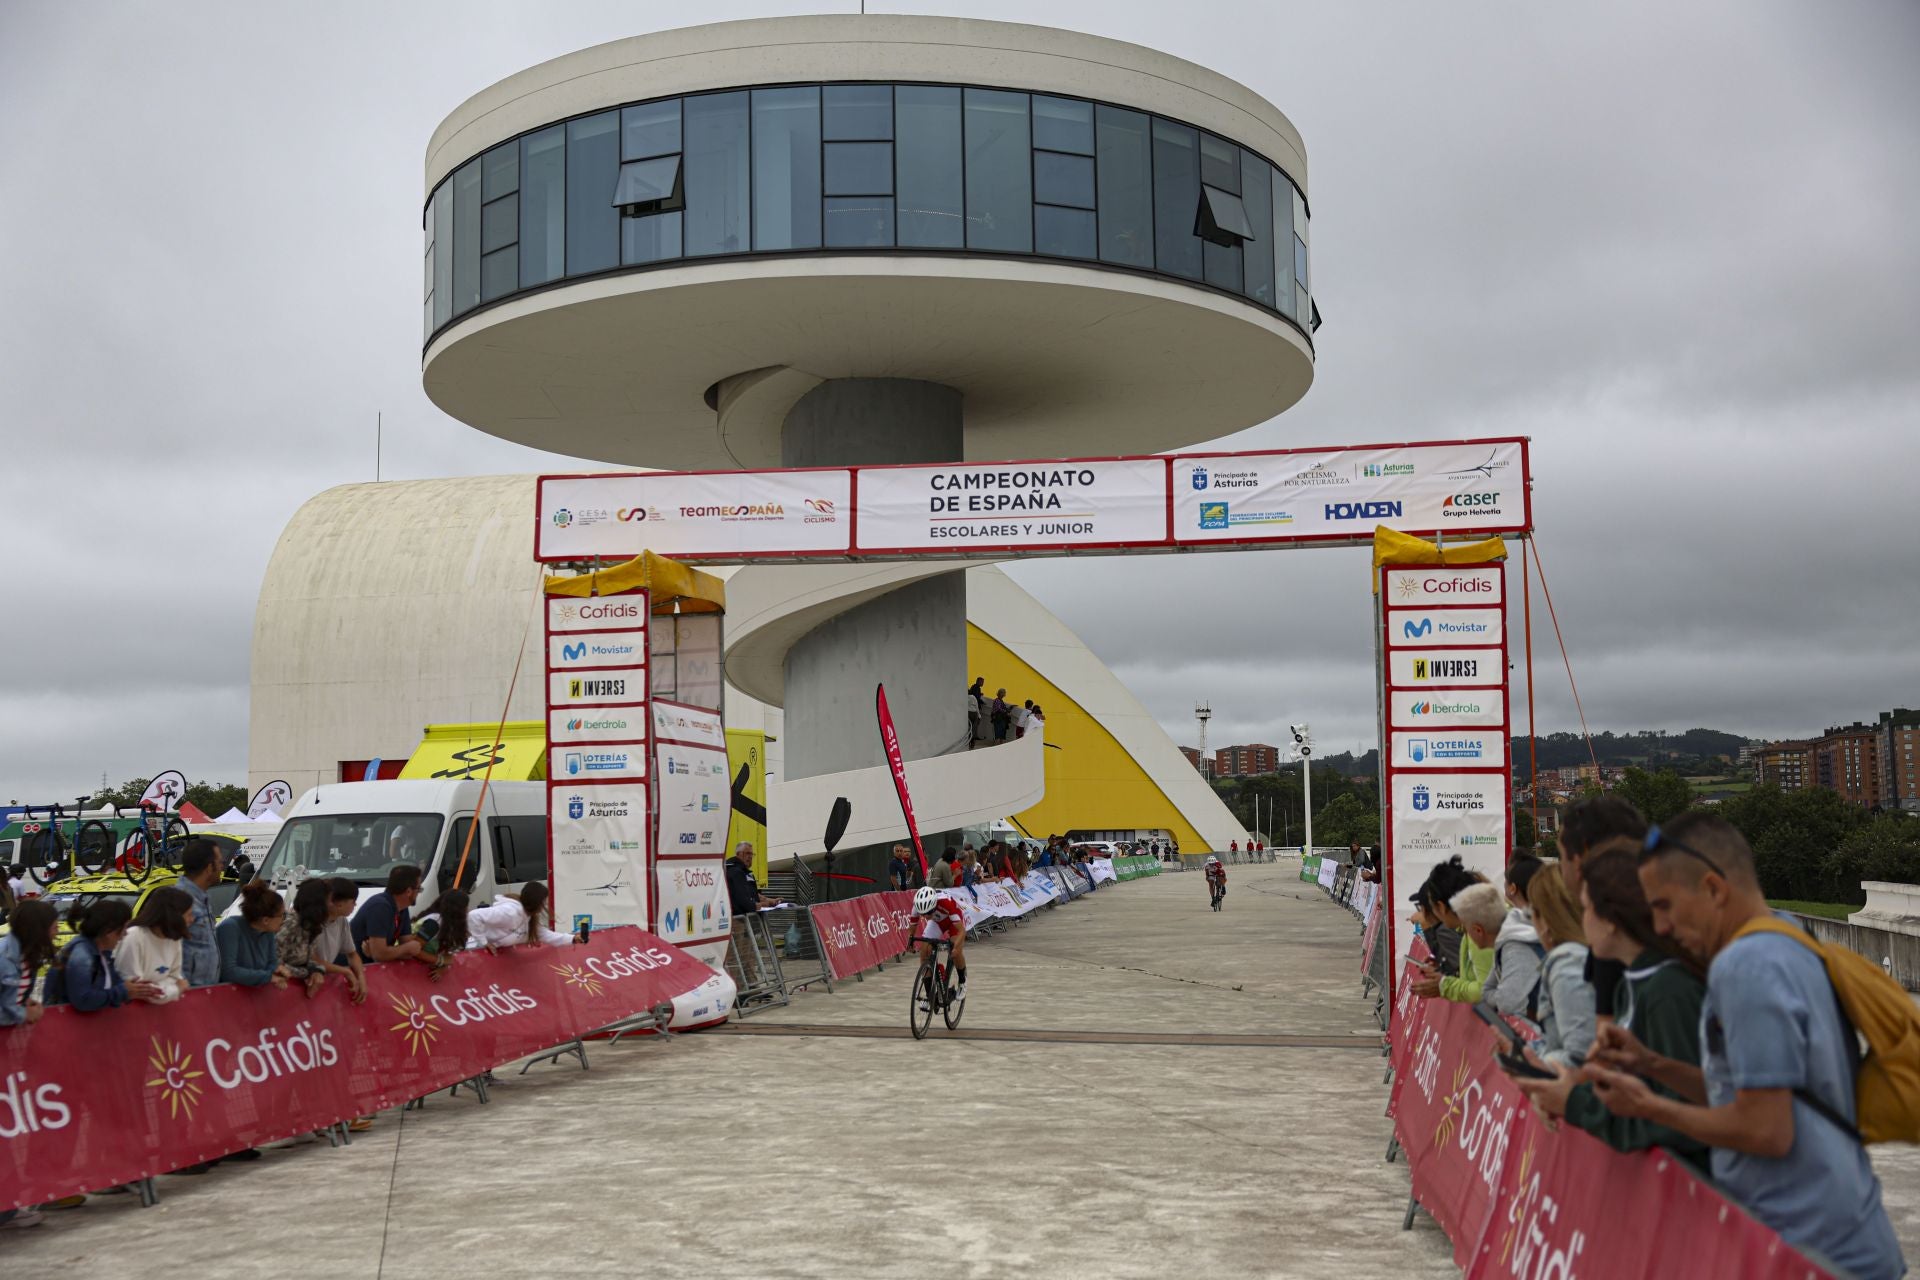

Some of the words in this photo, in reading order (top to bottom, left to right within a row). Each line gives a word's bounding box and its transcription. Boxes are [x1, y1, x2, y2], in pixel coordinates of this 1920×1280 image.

[1384, 463, 1414, 471] Asturias
[930, 469, 1095, 491] CAMPEONATO
[1296, 471, 1337, 479] CICLISMO
[1214, 478, 1259, 488] Asturias
[1284, 479, 1300, 487] POR
[1302, 478, 1350, 486] NATURALEZA
[930, 496, 960, 512] DE
[968, 489, 1062, 512] ESPAÑA
[1454, 492, 1500, 506] caser
[578, 509, 608, 518] CESA
[1325, 501, 1402, 520] HOWDEN
[1443, 510, 1468, 518] Grupo
[1470, 508, 1501, 516] Helvetia
[804, 516, 836, 524] CICLISMO
[930, 525, 1019, 538] ESCOLARES
[1023, 524, 1033, 536] Y
[1037, 522, 1094, 535] JUNIOR
[1424, 577, 1492, 593] Cofidis
[580, 604, 638, 619] Cofidis
[1439, 622, 1488, 633] Movistar
[592, 645, 633, 655] Movistar
[1432, 704, 1480, 714] Iberdrola
[584, 720, 626, 729] Iberdrola
[1431, 739, 1482, 750] LOTERÍAS
[584, 753, 628, 762] LOTERÍAS
[1436, 799, 1484, 809] Asturias
[589, 807, 628, 817] Asturias
[684, 868, 714, 887] Cofidis
[832, 922, 858, 949] Cofidis
[585, 945, 672, 981] Cofidis
[430, 983, 538, 1026] Cofidis
[205, 1020, 338, 1090] Cofidis
